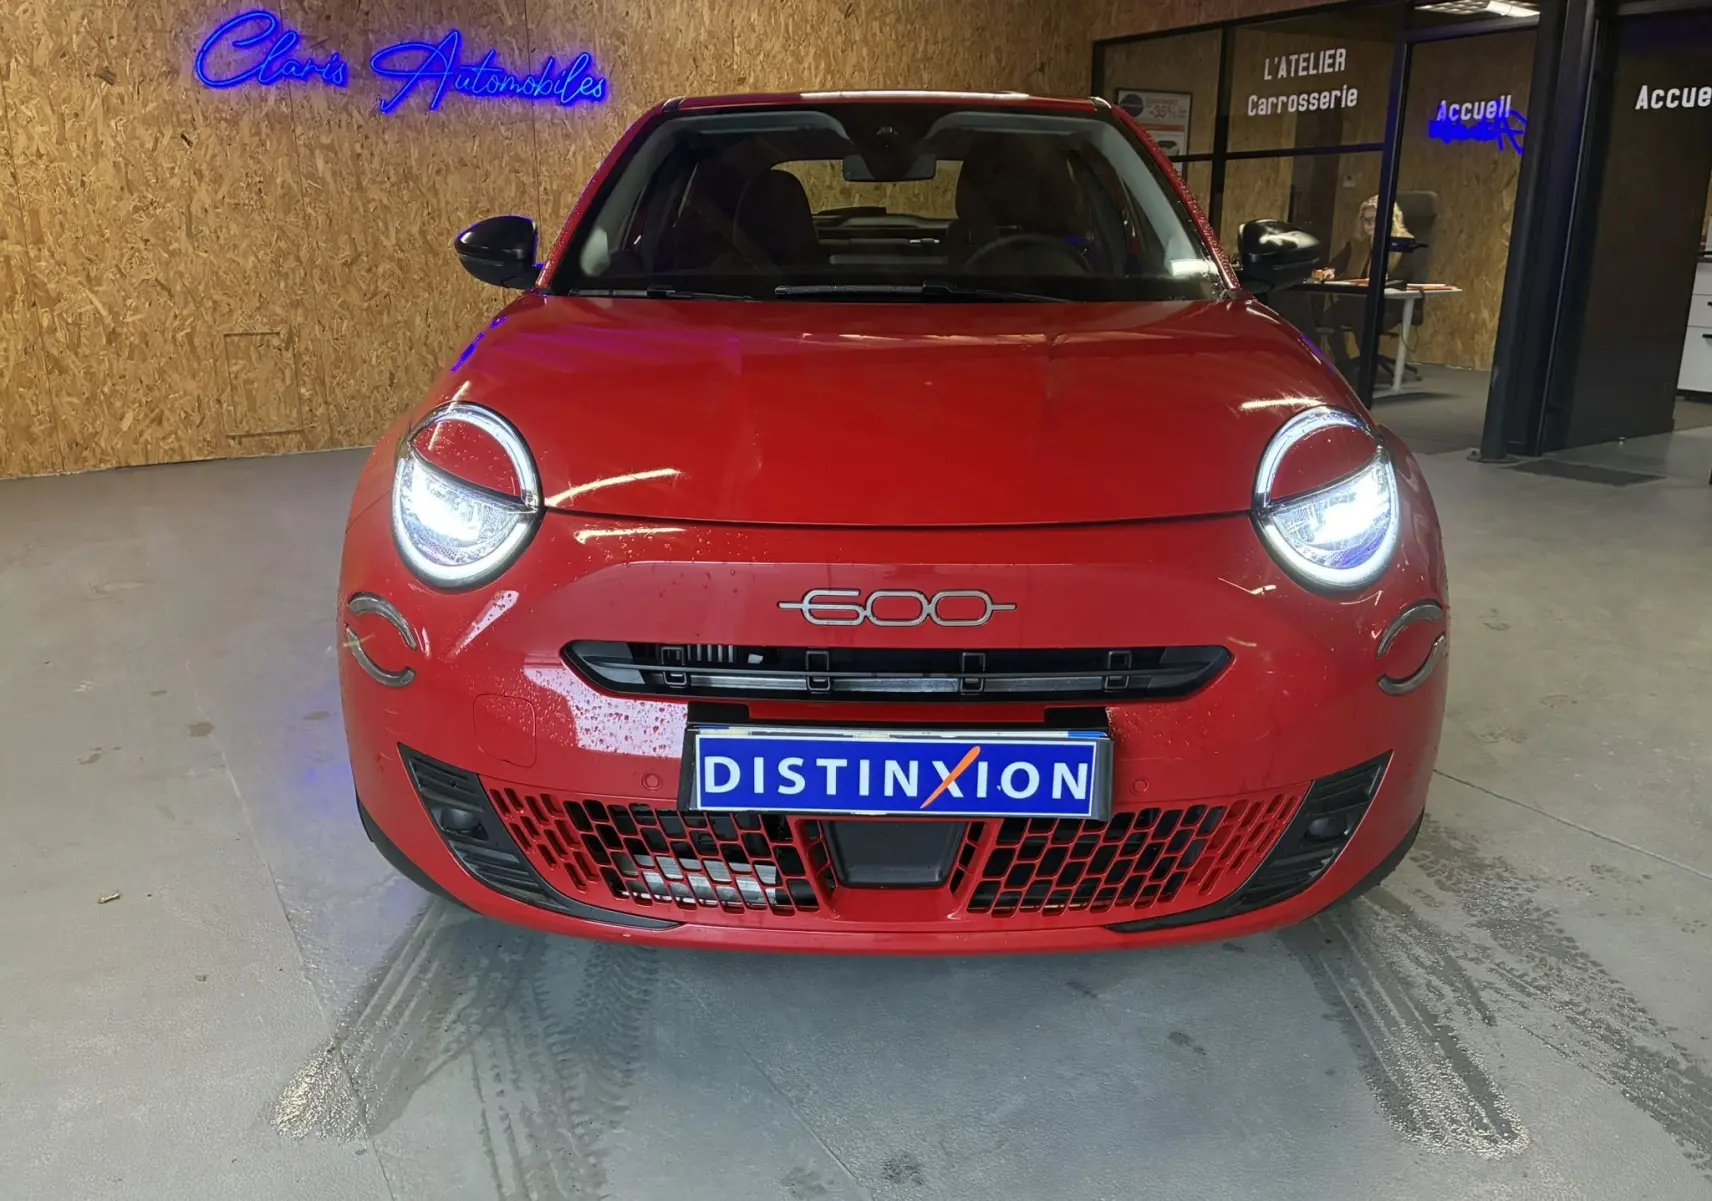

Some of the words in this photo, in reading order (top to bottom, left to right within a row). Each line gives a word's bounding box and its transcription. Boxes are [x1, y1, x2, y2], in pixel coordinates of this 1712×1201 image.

[196, 11, 347, 89] Claris
[370, 29, 607, 112] Automobiles
[1263, 48, 1347, 80] L'ATELIER
[1247, 84, 1358, 116] Carrosserie
[1435, 94, 1512, 122] Accueil
[777, 588, 1017, 627] 600
[703, 746, 1089, 809] DISTINXION
